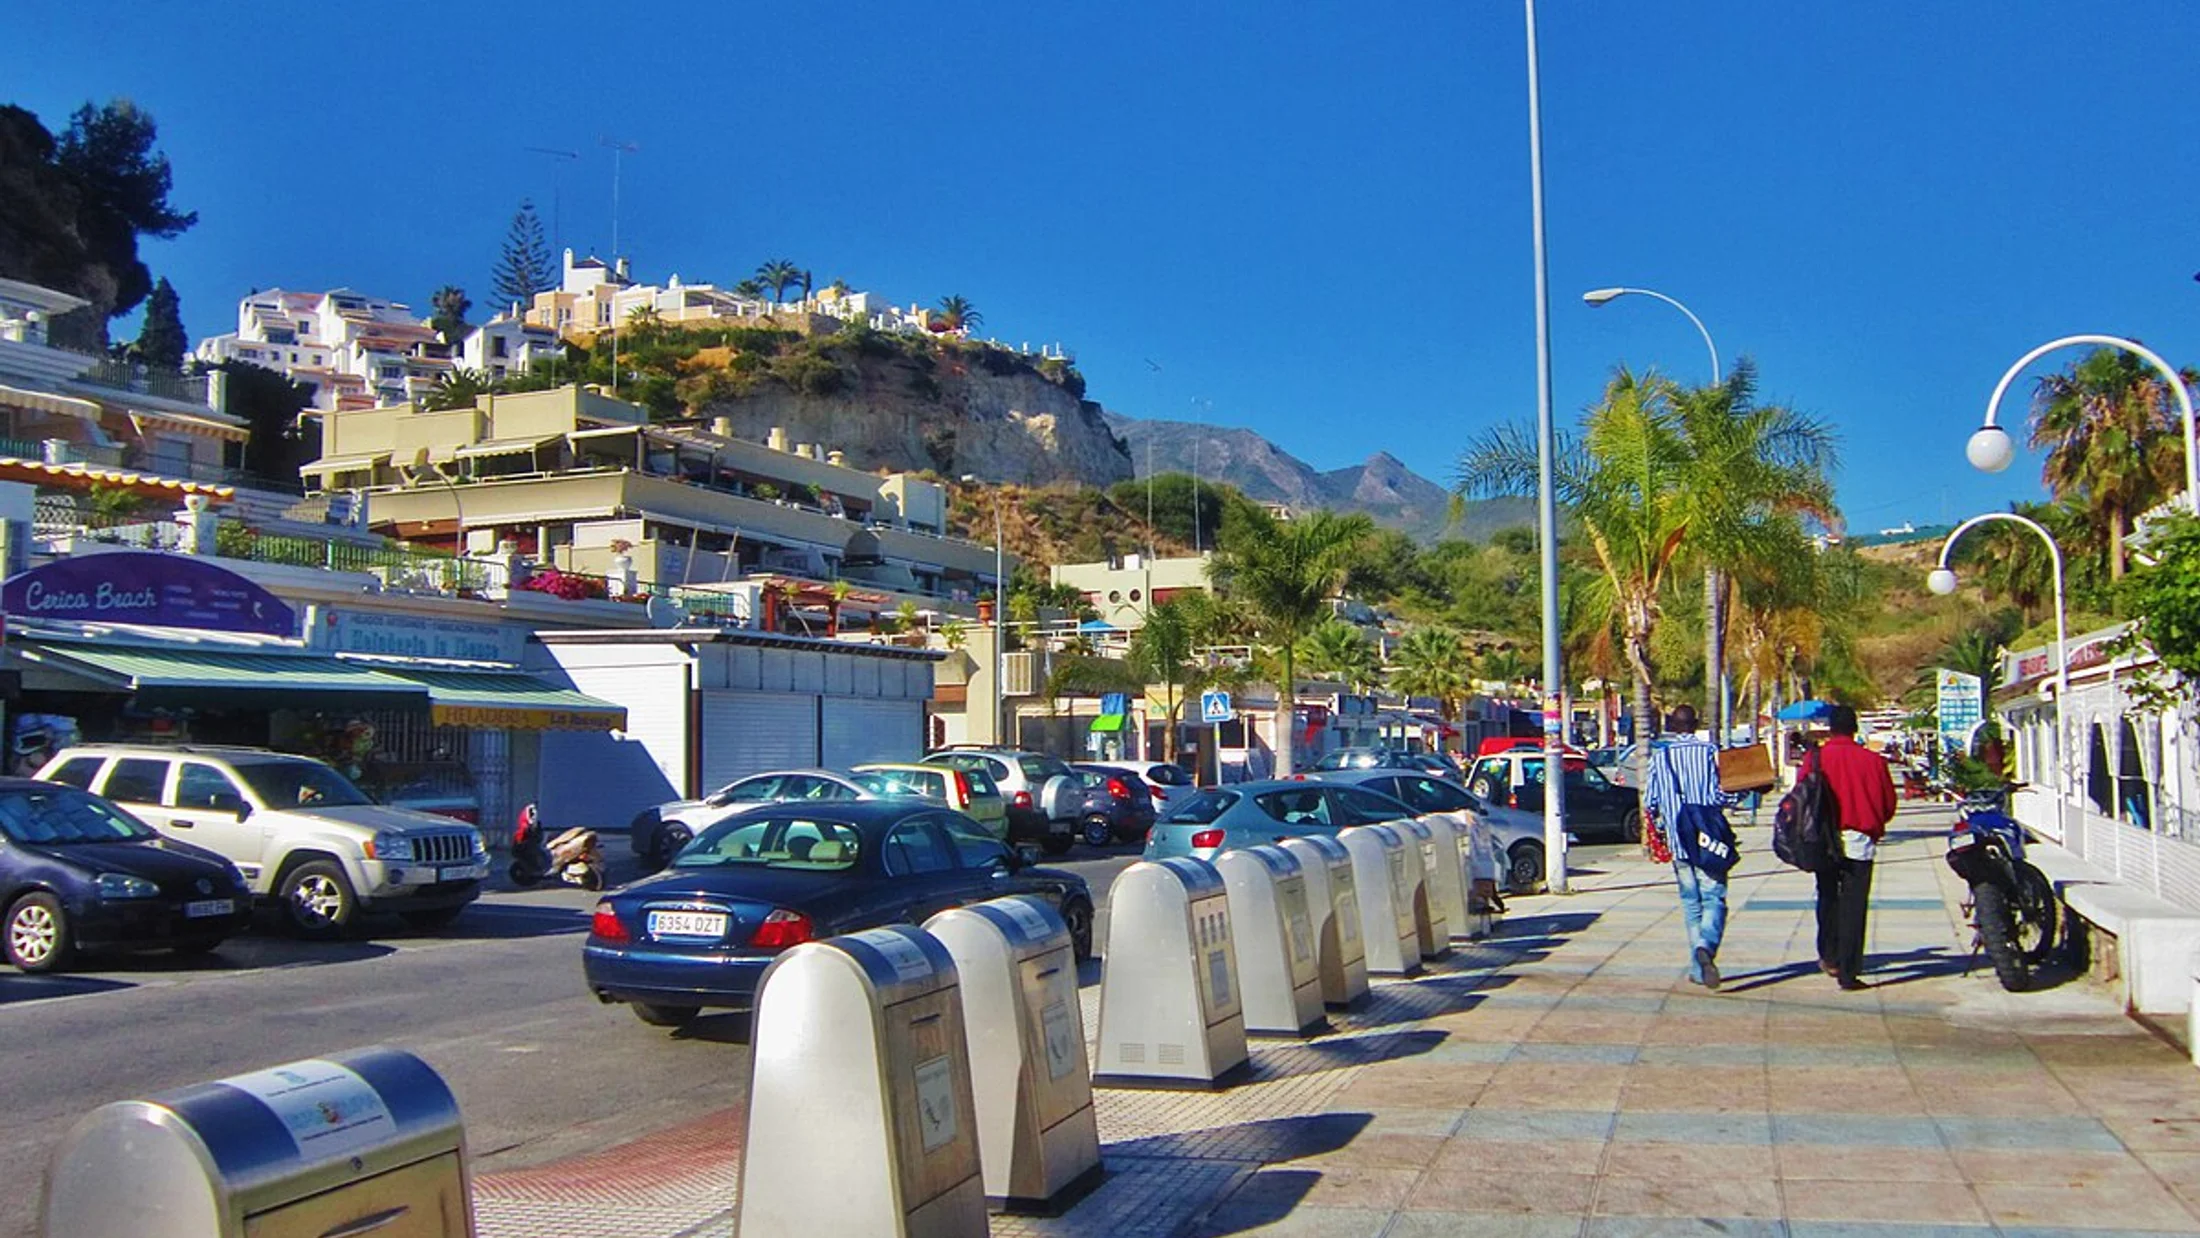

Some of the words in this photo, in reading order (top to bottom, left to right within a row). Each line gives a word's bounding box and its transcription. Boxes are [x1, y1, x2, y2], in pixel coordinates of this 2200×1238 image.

[26, 581, 90, 610] Cerica
[96, 582, 157, 609] Beach
[658, 915, 690, 931] 6354
